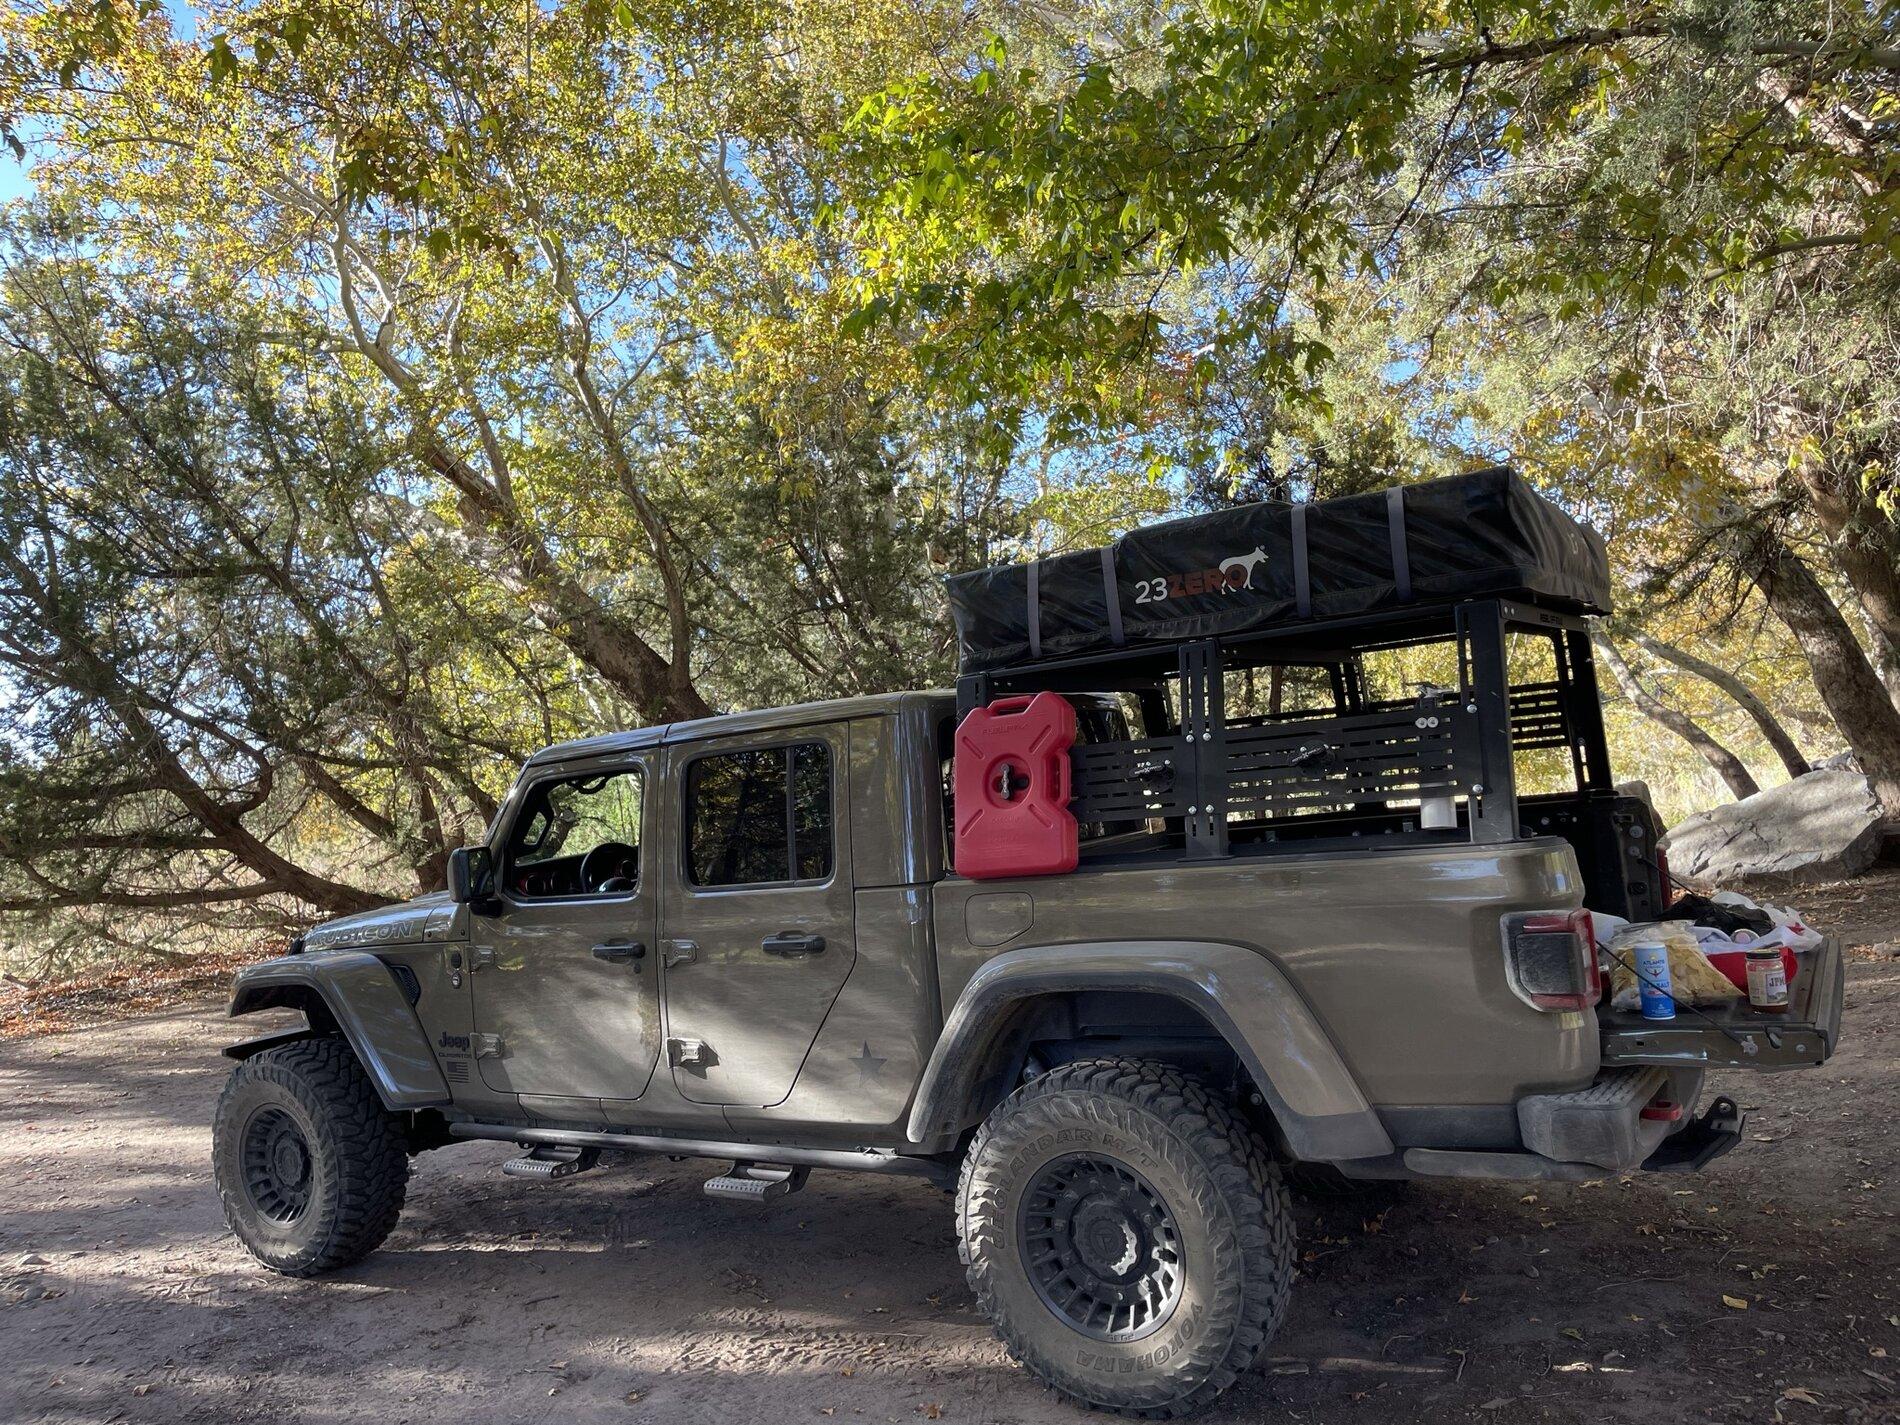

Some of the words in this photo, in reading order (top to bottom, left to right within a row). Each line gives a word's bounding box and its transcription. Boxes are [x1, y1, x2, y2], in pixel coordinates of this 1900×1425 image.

[1135, 564, 1248, 604] 23ZERO
[439, 1031, 470, 1052] Jeep
[993, 1128, 1094, 1249] GEOLANDAR
[1076, 1302, 1202, 1373] YOKOHAMA
